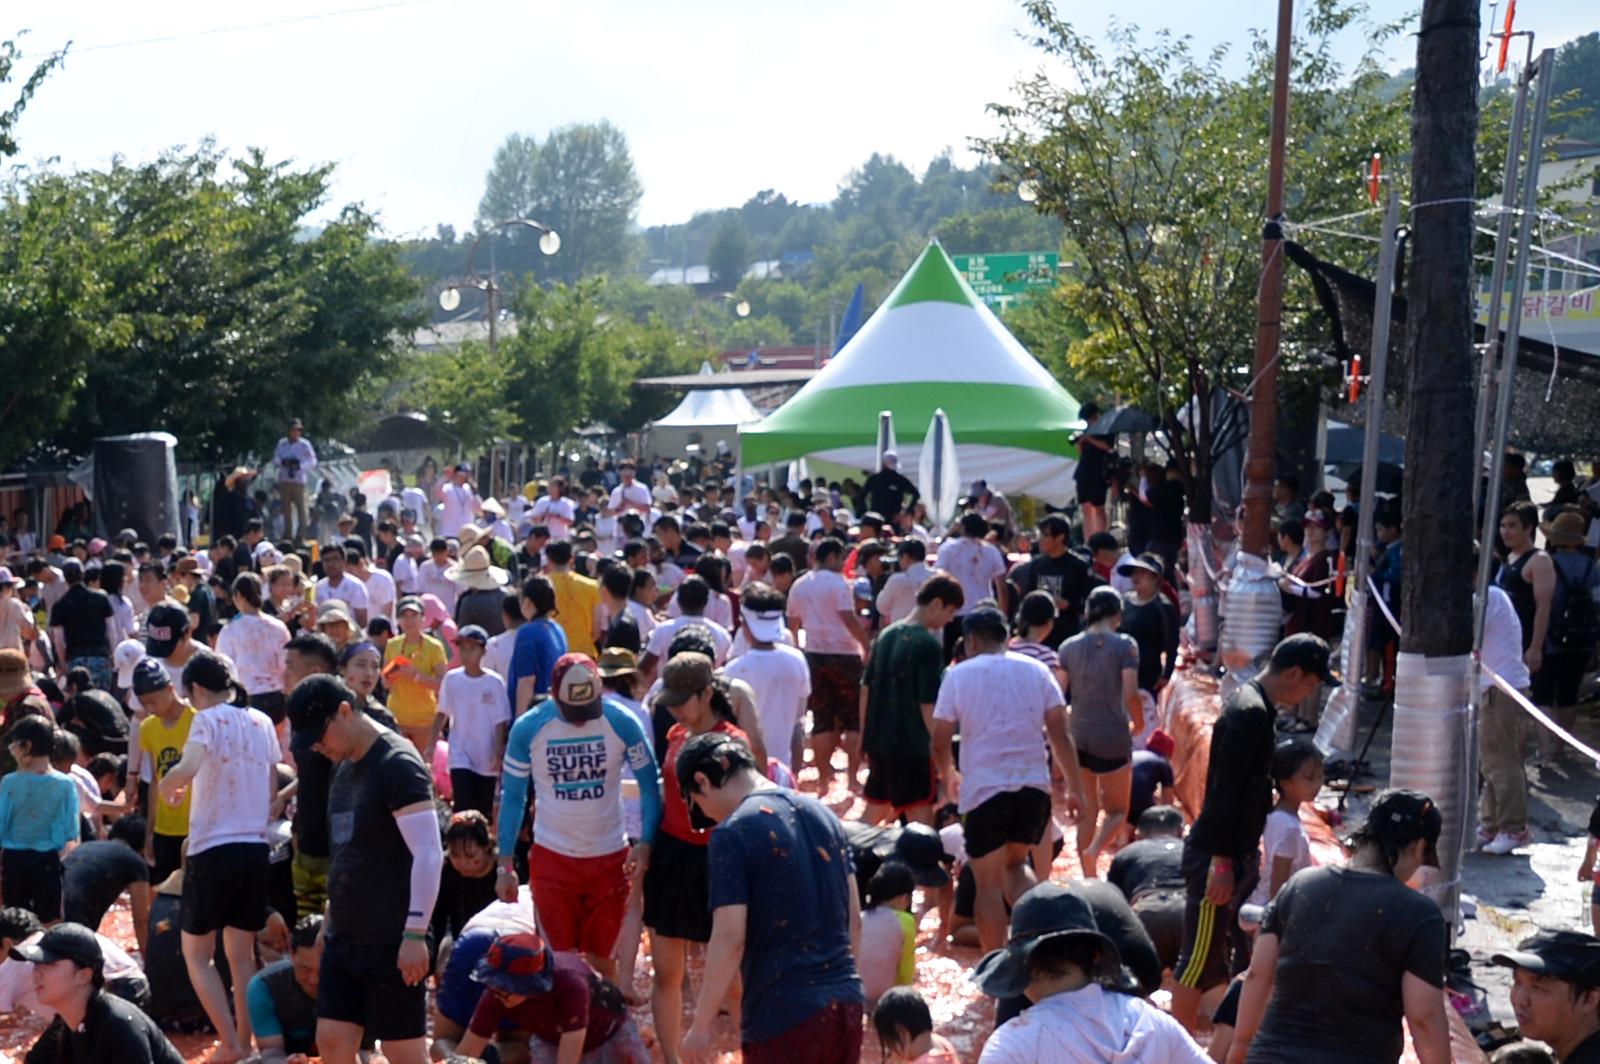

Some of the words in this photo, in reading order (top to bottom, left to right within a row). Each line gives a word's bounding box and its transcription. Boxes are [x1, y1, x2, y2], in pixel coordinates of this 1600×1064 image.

[1522, 294, 1591, 317] 닭갈비
[546, 742, 606, 756] REBELS
[547, 754, 607, 772] SURF
[549, 769, 607, 784] TEAM
